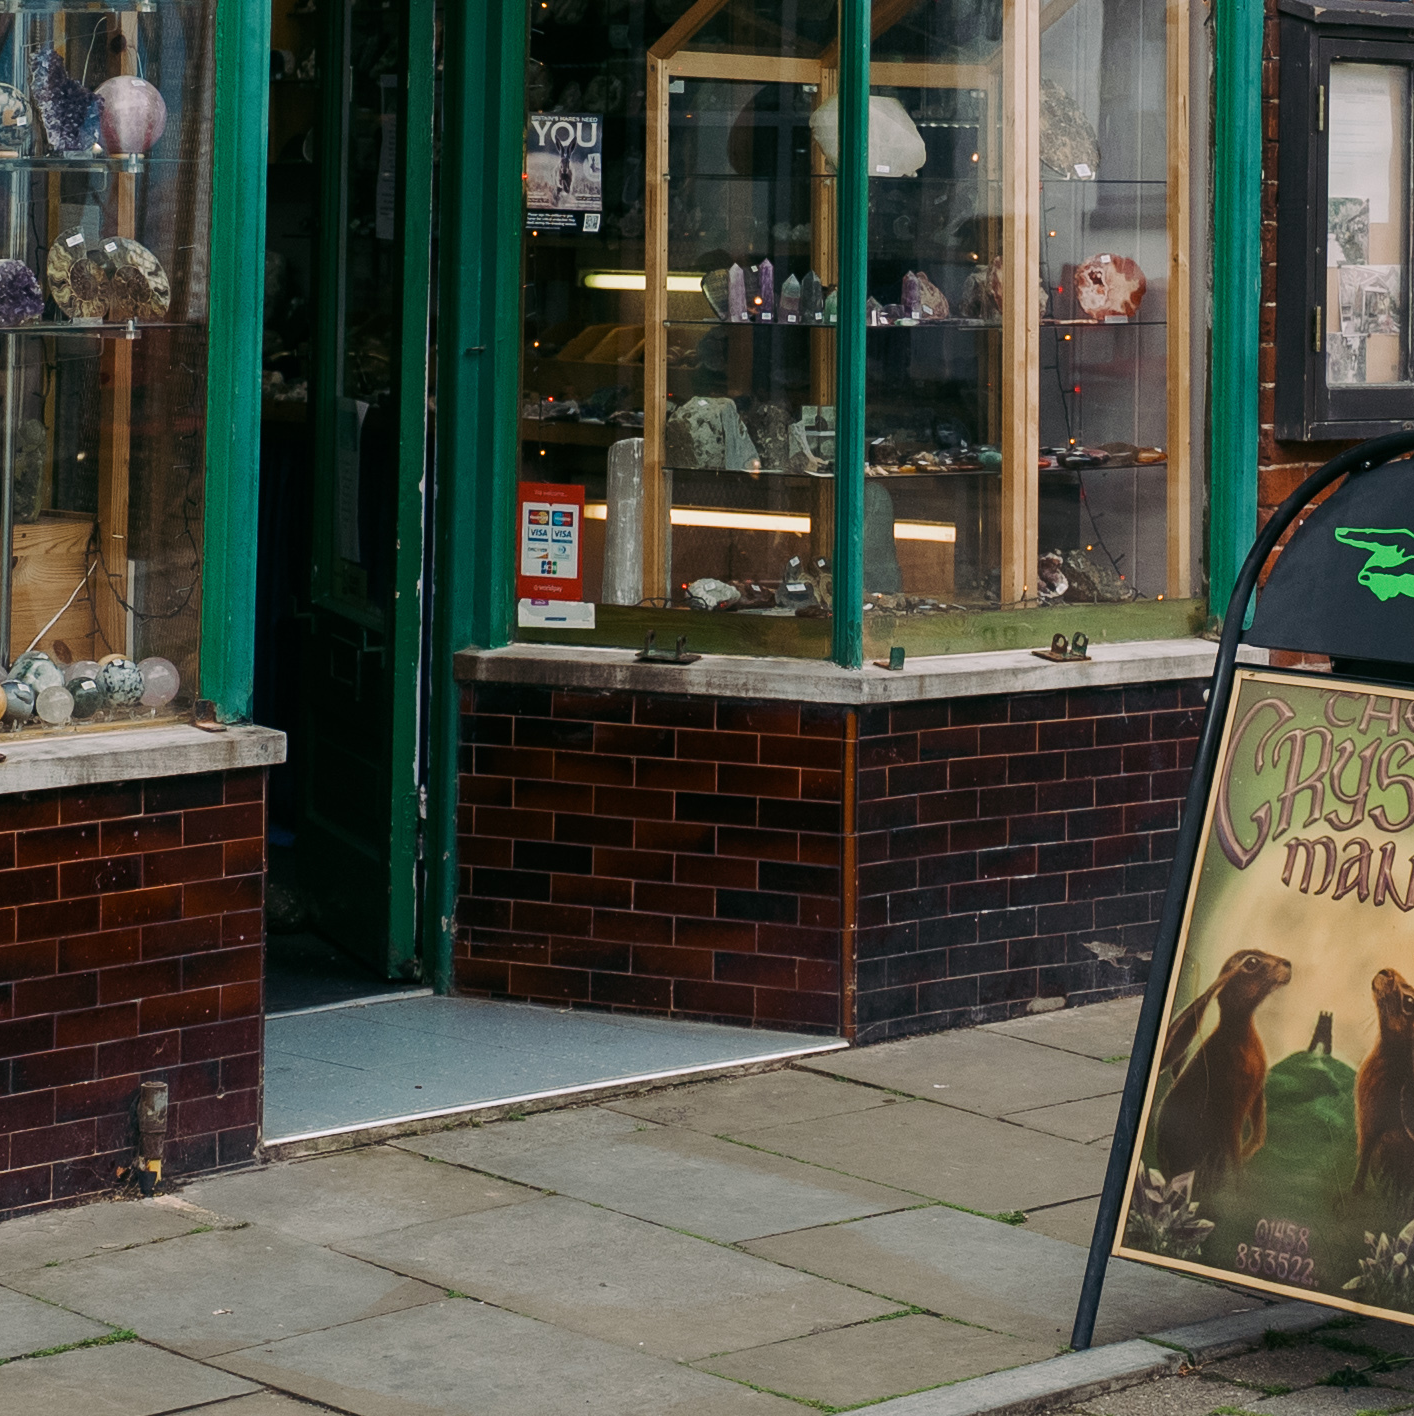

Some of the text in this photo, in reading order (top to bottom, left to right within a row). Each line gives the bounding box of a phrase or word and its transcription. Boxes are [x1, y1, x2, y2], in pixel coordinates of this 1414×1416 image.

[531, 120, 598, 148] YOU
[530, 528, 572, 538] VISA VISA
[1254, 1218, 1310, 1254] 01458
